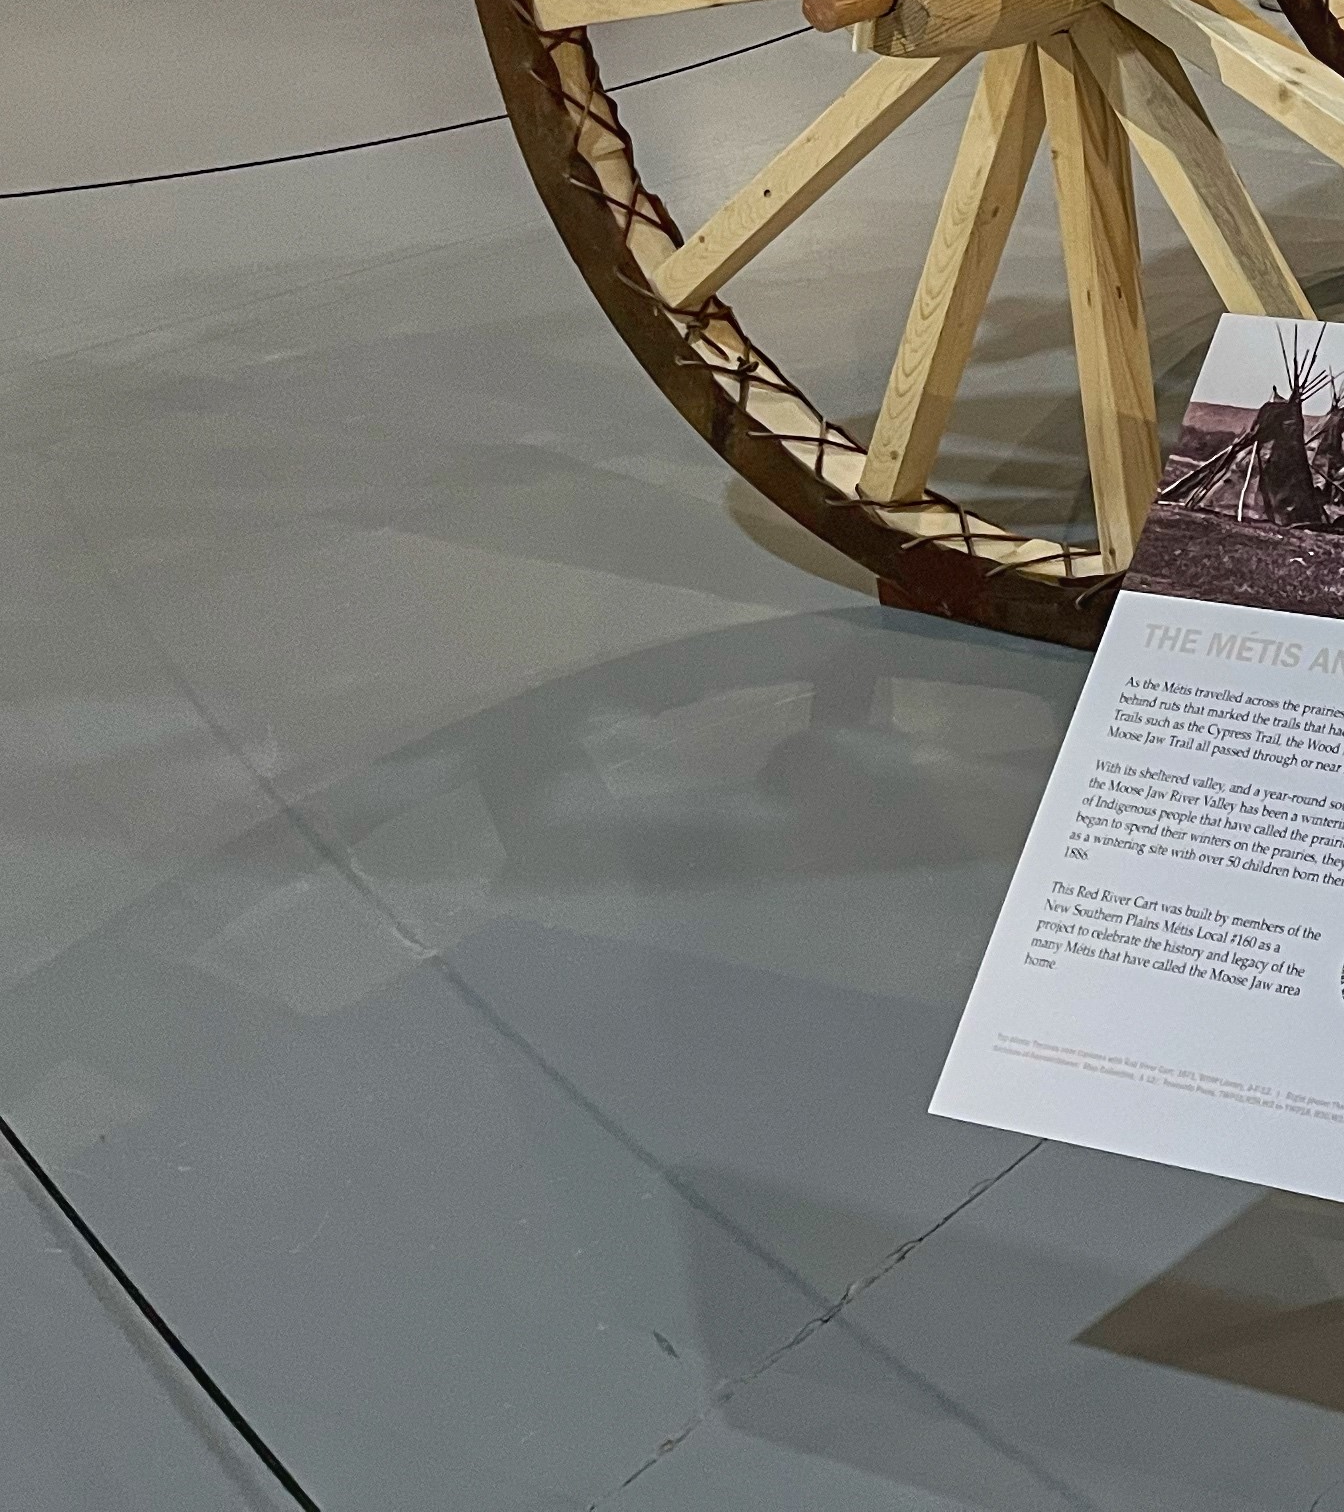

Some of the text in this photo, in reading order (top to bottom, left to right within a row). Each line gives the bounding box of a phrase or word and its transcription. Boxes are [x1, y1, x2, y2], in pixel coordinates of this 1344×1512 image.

[1145, 623, 1201, 653] THE
[1207, 629, 1302, 667] MÉTIS
[1119, 691, 1158, 707] behind
[1158, 701, 1181, 711] ruts
[1183, 701, 1205, 715] that
[1206, 708, 1251, 721] marked
[1251, 712, 1271, 725] the
[1272, 716, 1301, 729] trails
[1303, 720, 1326, 733] that
[1125, 676, 1140, 687] As
[1142, 678, 1161, 690] the
[1194, 687, 1244, 703] travelled
[1244, 696, 1280, 708] across
[1282, 699, 1301, 711] the
[1107, 725, 1144, 741] Moose
[1143, 731, 1166, 744] Jaw
[1169, 735, 1195, 749] Trail
[1195, 739, 1211, 751] all
[1210, 745, 1251, 758] passed
[1252, 749, 1298, 767] through
[1300, 759, 1315, 768] or
[1315, 761, 1342, 772] near
[1114, 708, 1143, 723] Trails
[1144, 716, 1171, 728] such
[1172, 721, 1185, 729] as
[1187, 720, 1205, 733] the
[1207, 723, 1252, 740] Cypress
[1285, 735, 1305, 748] the
[1307, 737, 1342, 753] Wood
[1088, 776, 1106, 789] the
[1107, 779, 1145, 796] Moose
[1144, 785, 1169, 799] Jaw
[1169, 789, 1201, 805] River
[1204, 794, 1238, 814] Valley
[1238, 800, 1259, 815] has
[1261, 804, 1289, 820] been
[1290, 812, 1298, 821] a
[1095, 759, 1122, 773] With
[1123, 765, 1137, 776] its
[1138, 766, 1191, 784] sheltered
[1192, 776, 1226, 793] valley,
[1228, 783, 1253, 795] and
[1252, 788, 1261, 796] a
[1260, 789, 1328, 807] year-round
[1075, 810, 1109, 827] began
[1110, 818, 1123, 829] to
[1124, 822, 1159, 835] spend
[1160, 825, 1188, 839] their
[1190, 833, 1232, 847] winters
[1233, 841, 1249, 851] on
[1251, 841, 1270, 854] the
[1270, 847, 1318, 864] prairies,
[1081, 794, 1096, 806] of
[1095, 795, 1157, 816] Indigenous
[1157, 809, 1198, 824] people
[1199, 813, 1222, 827] that
[1223, 816, 1252, 832] have
[1253, 823, 1289, 838] called
[1289, 828, 1309, 842] the
[1069, 831, 1082, 840] as
[1083, 833, 1090, 841] a
[1093, 835, 1147, 855] wintering
[1148, 843, 1169, 855] site
[1171, 847, 1197, 860] with
[1198, 853, 1225, 865] over
[1225, 855, 1242, 867] 50
[1241, 858, 1290, 877] children
[1044, 898, 1071, 913] New
[1072, 903, 1123, 923] Southern
[1125, 913, 1160, 930] Plains
[1196, 926, 1229, 943] Local
[1257, 941, 1272, 951] as
[1273, 943, 1281, 953] a
[1051, 881, 1322, 940] This Red River Cart was built by members of the
[1035, 919, 1306, 977] project to celebrate the history and legacy of the
